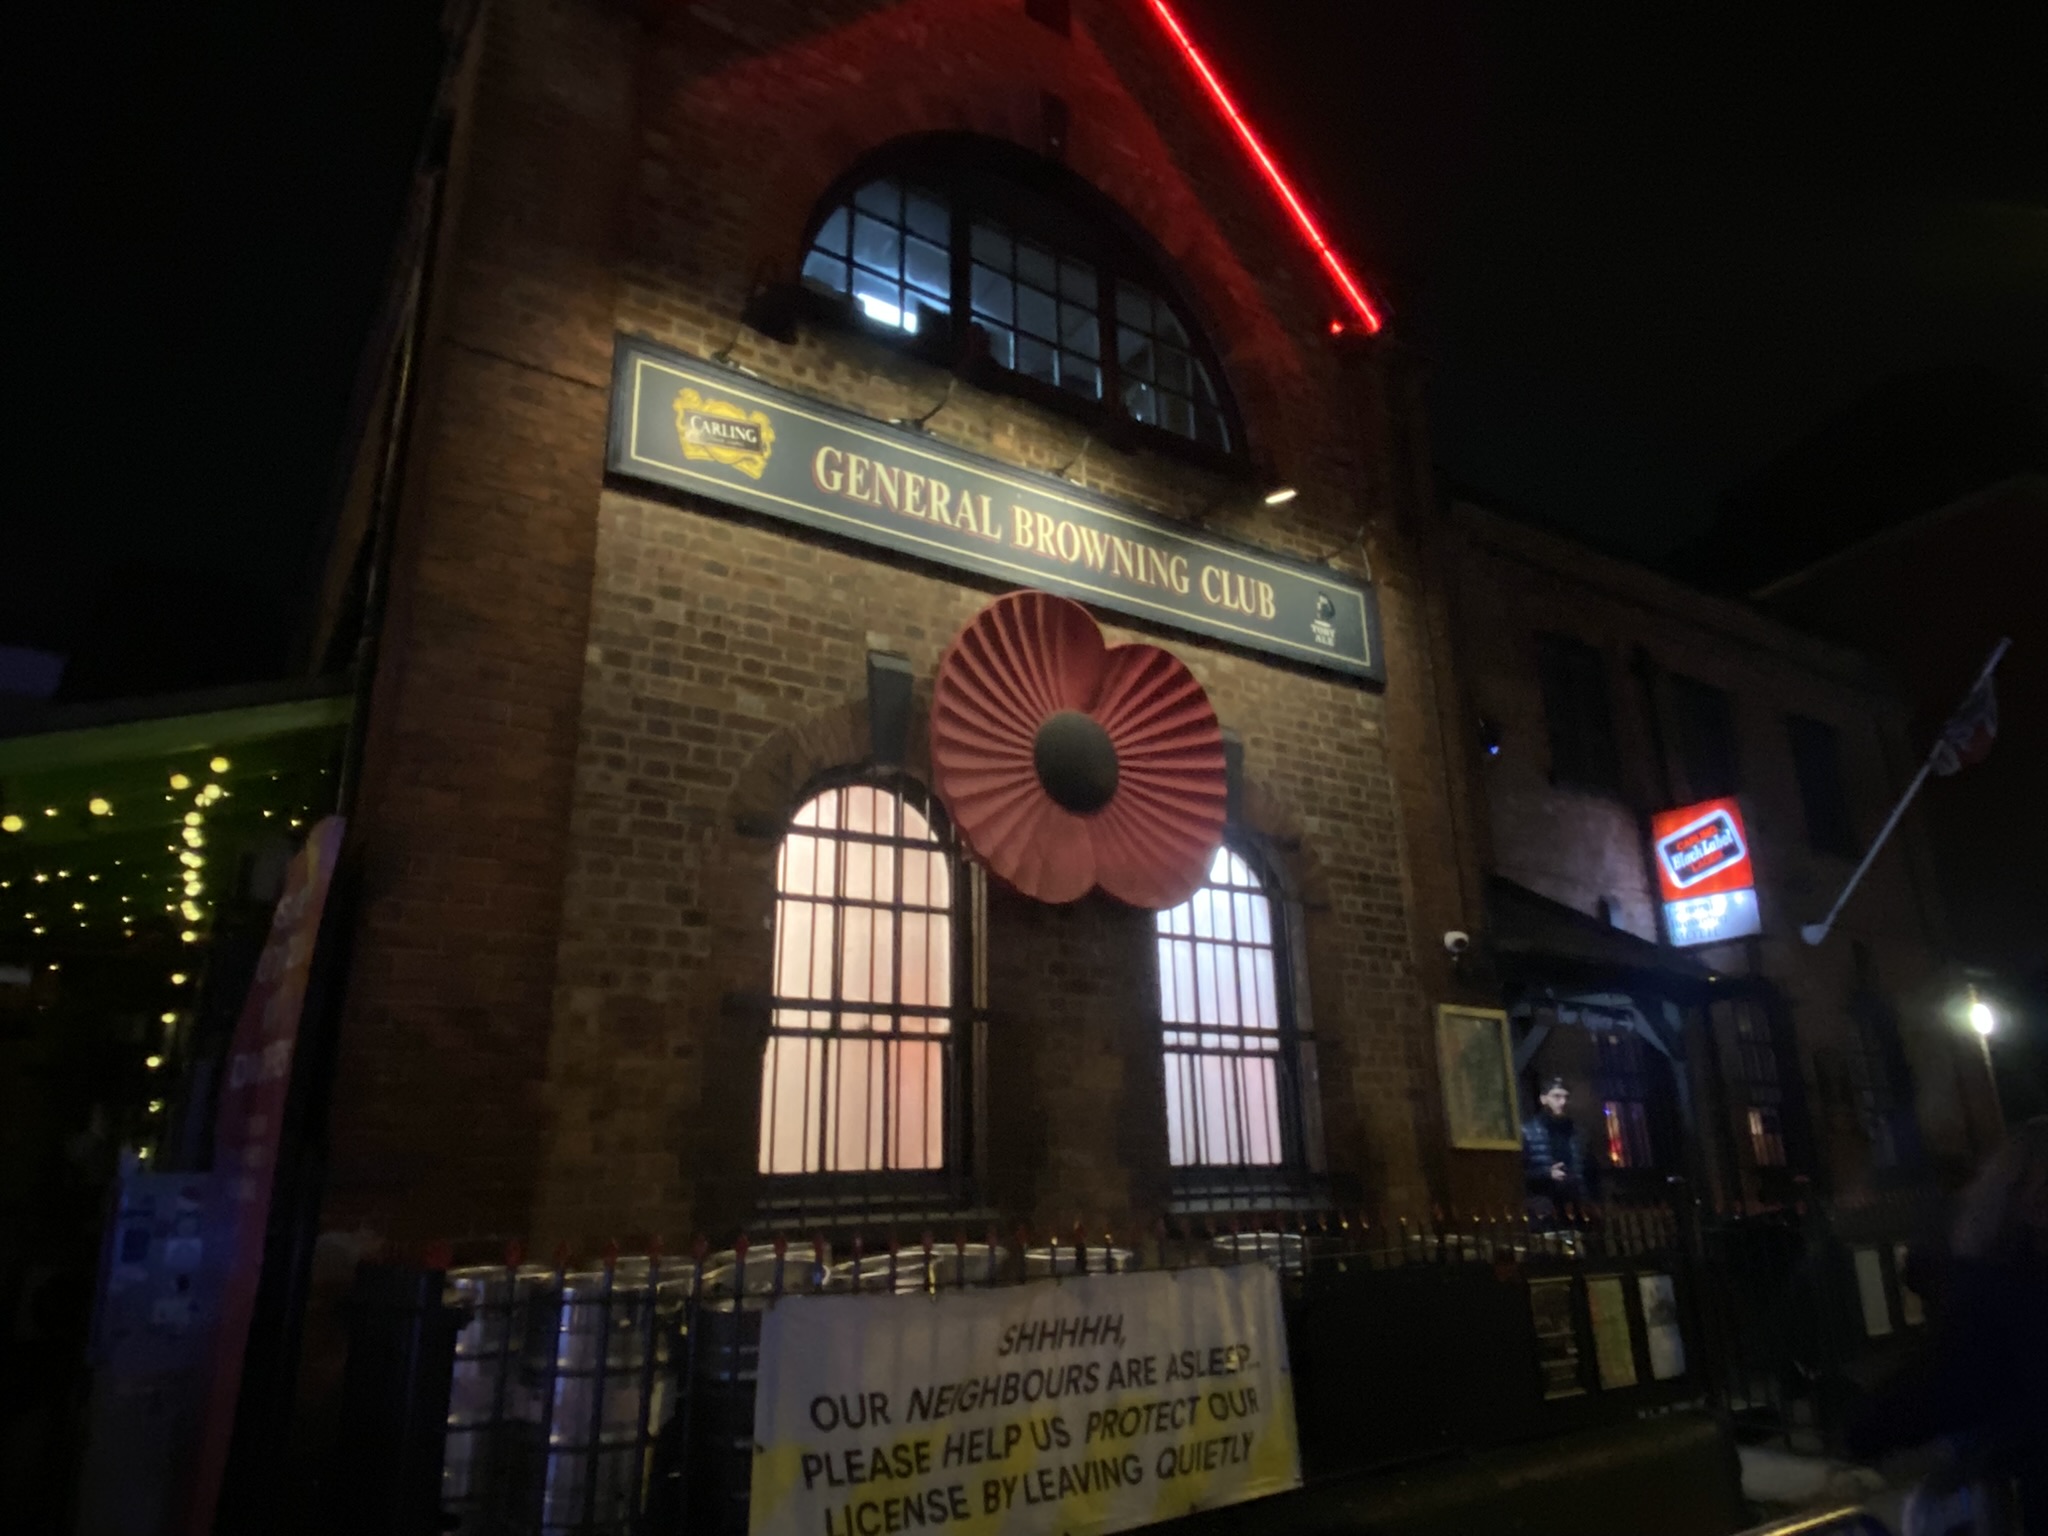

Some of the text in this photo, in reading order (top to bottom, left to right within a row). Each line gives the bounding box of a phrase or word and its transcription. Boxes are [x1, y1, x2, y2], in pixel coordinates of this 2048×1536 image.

[690, 414, 758, 444] CARLING
[812, 445, 1277, 620] GENERAL BROWNING CLUB
[801, 1386, 1260, 1490] PLEASE HELP US PROTECT OUR
[810, 1393, 891, 1432] OUR
[905, 1363, 1101, 1424] NEIGHBOURS
[1106, 1357, 1158, 1391] ARE
[824, 1431, 1256, 1536] LICENSE BY LEAVING QUIETLY
